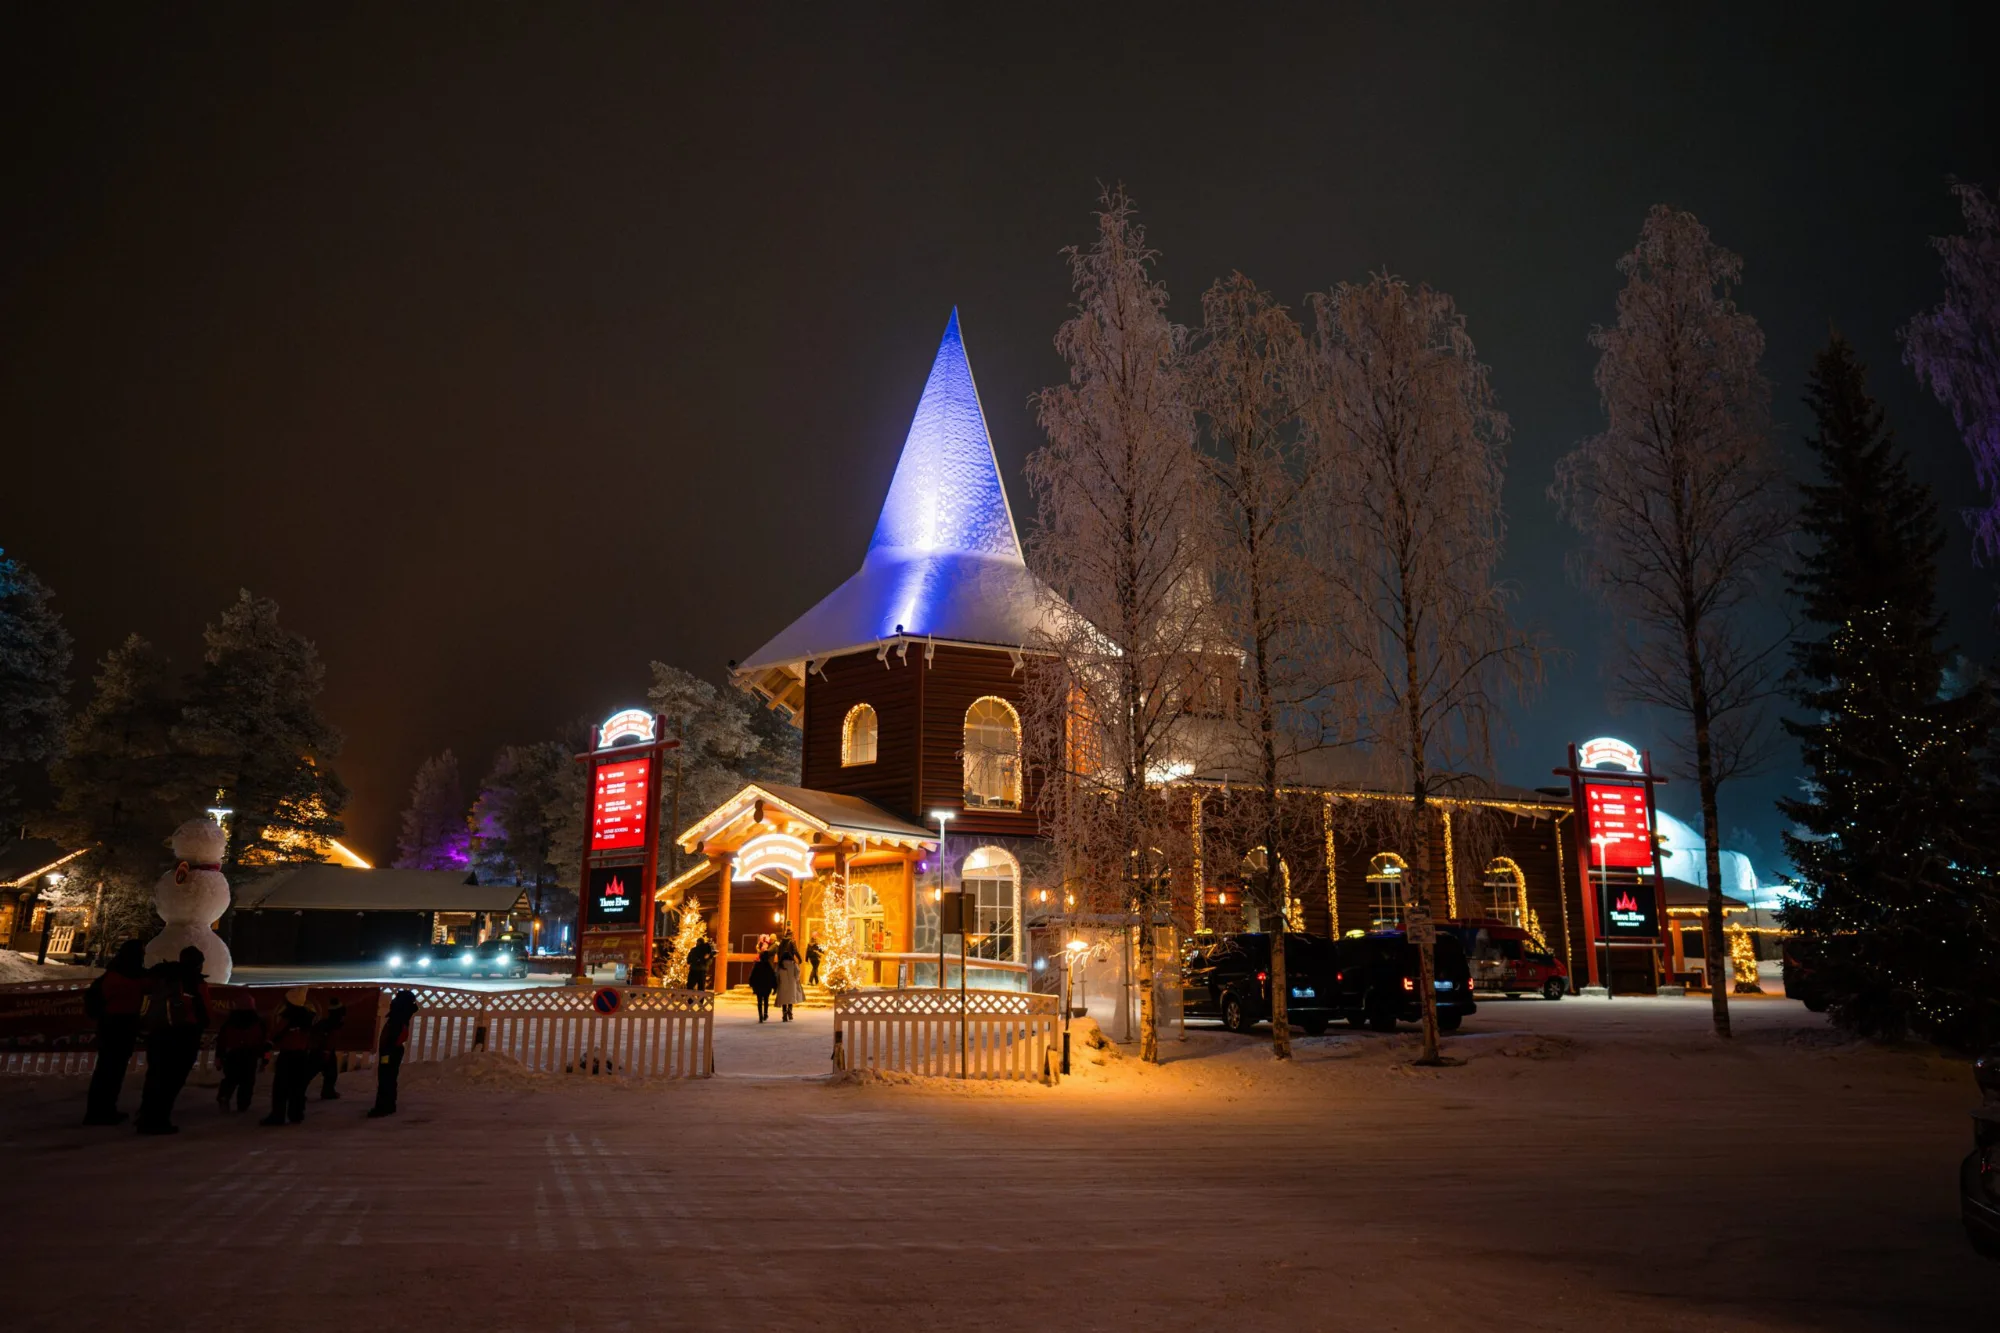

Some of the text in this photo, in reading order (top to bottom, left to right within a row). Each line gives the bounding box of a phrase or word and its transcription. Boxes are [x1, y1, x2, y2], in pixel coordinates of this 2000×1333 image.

[600, 896, 629, 907] Three Elves
[1610, 911, 1628, 921] Three
